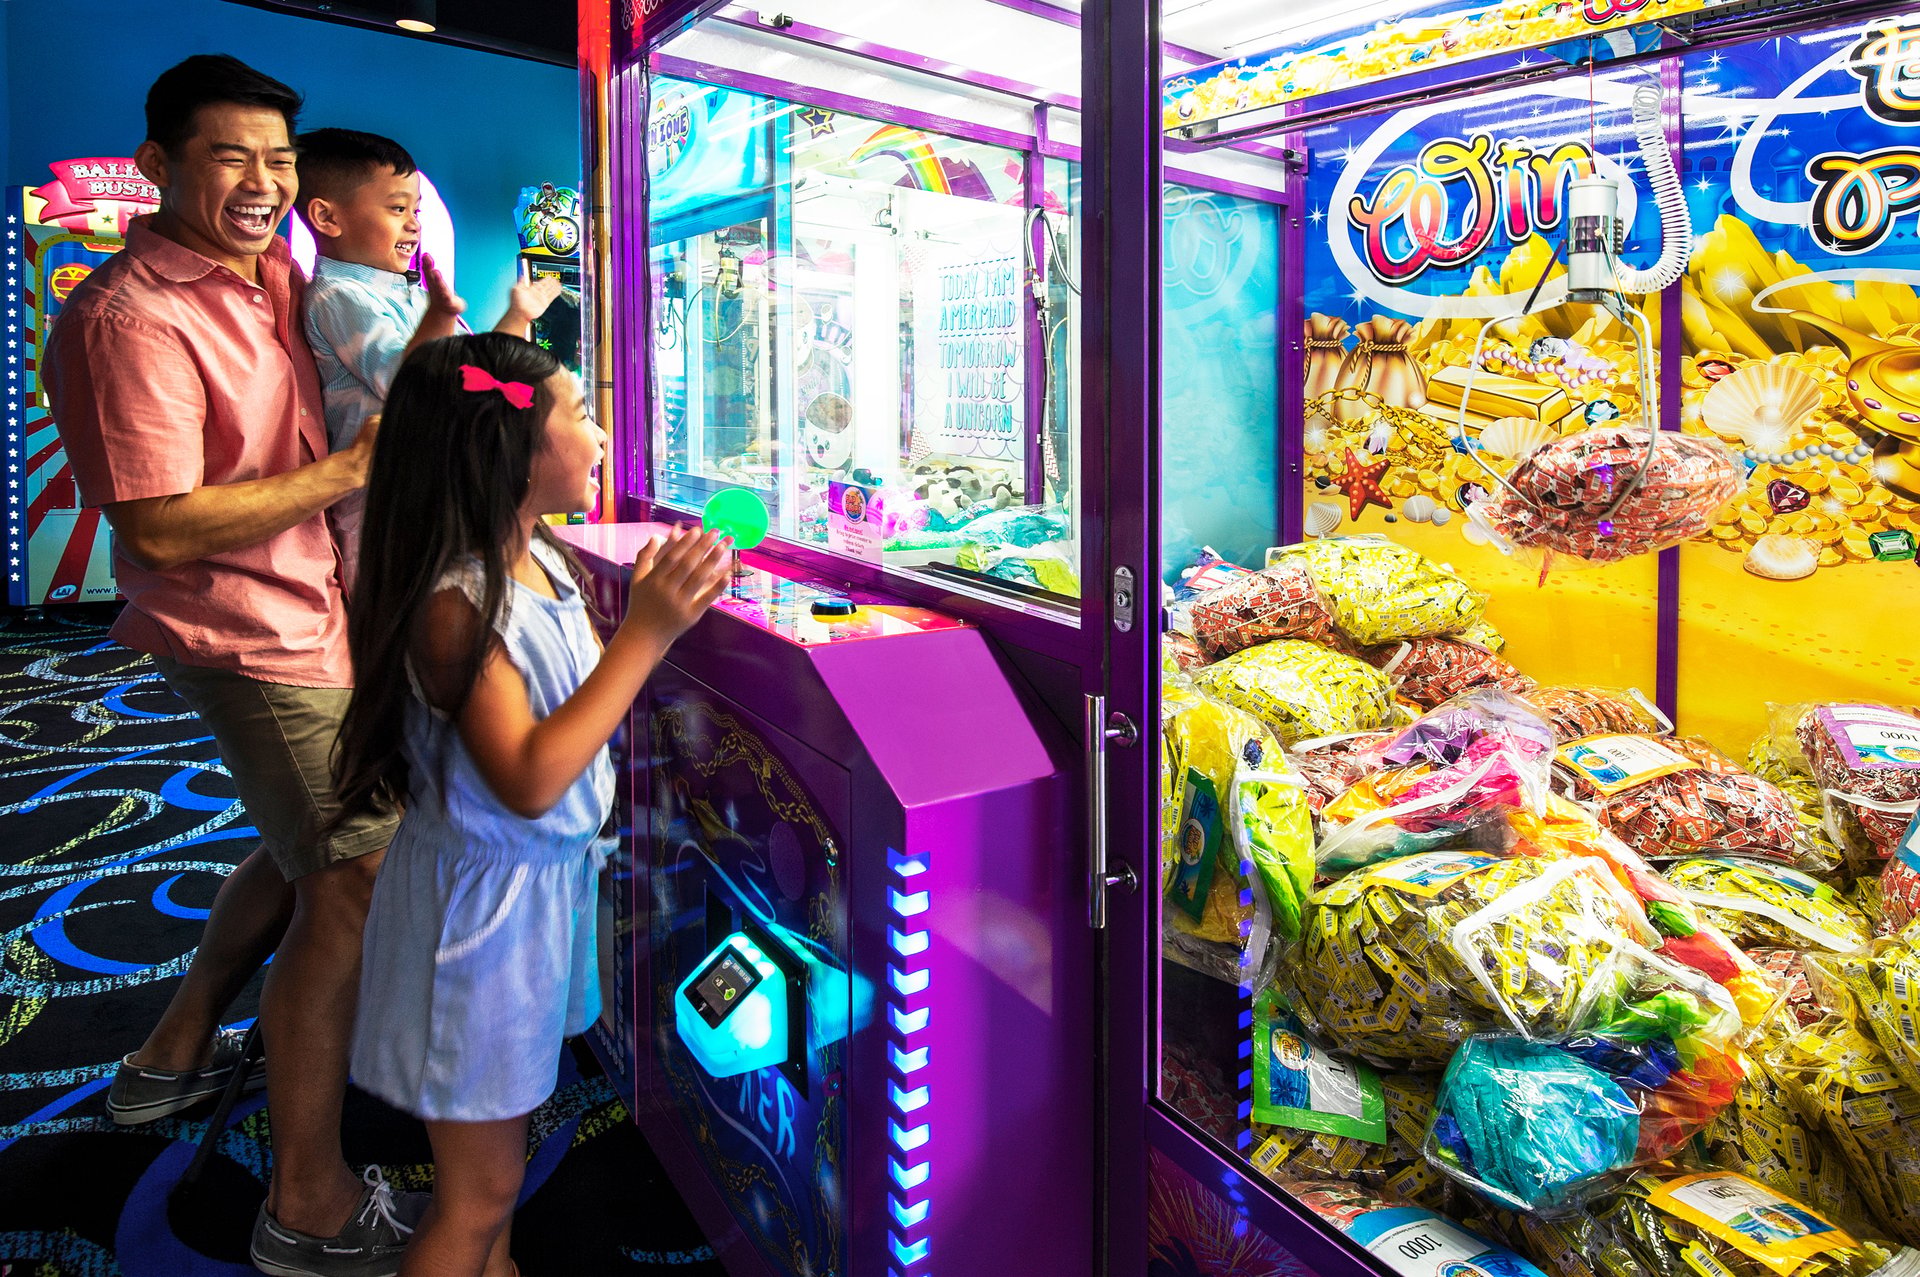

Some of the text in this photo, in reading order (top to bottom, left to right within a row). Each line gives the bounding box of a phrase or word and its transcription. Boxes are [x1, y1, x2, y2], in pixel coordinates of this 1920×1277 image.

[660, 112, 688, 144] ZONE
[70, 163, 151, 179] BALL
[1349, 131, 1593, 287] Win
[939, 271, 978, 301] TODAY
[992, 266, 1015, 296] AM
[939, 300, 1016, 331] A MERMAID
[939, 340, 1017, 369] TOMORROW
[956, 371, 986, 398] WILL
[991, 371, 1006, 399] BE
[944, 402, 1013, 433] A UNICORN
[1398, 1234, 1443, 1260] 1000
